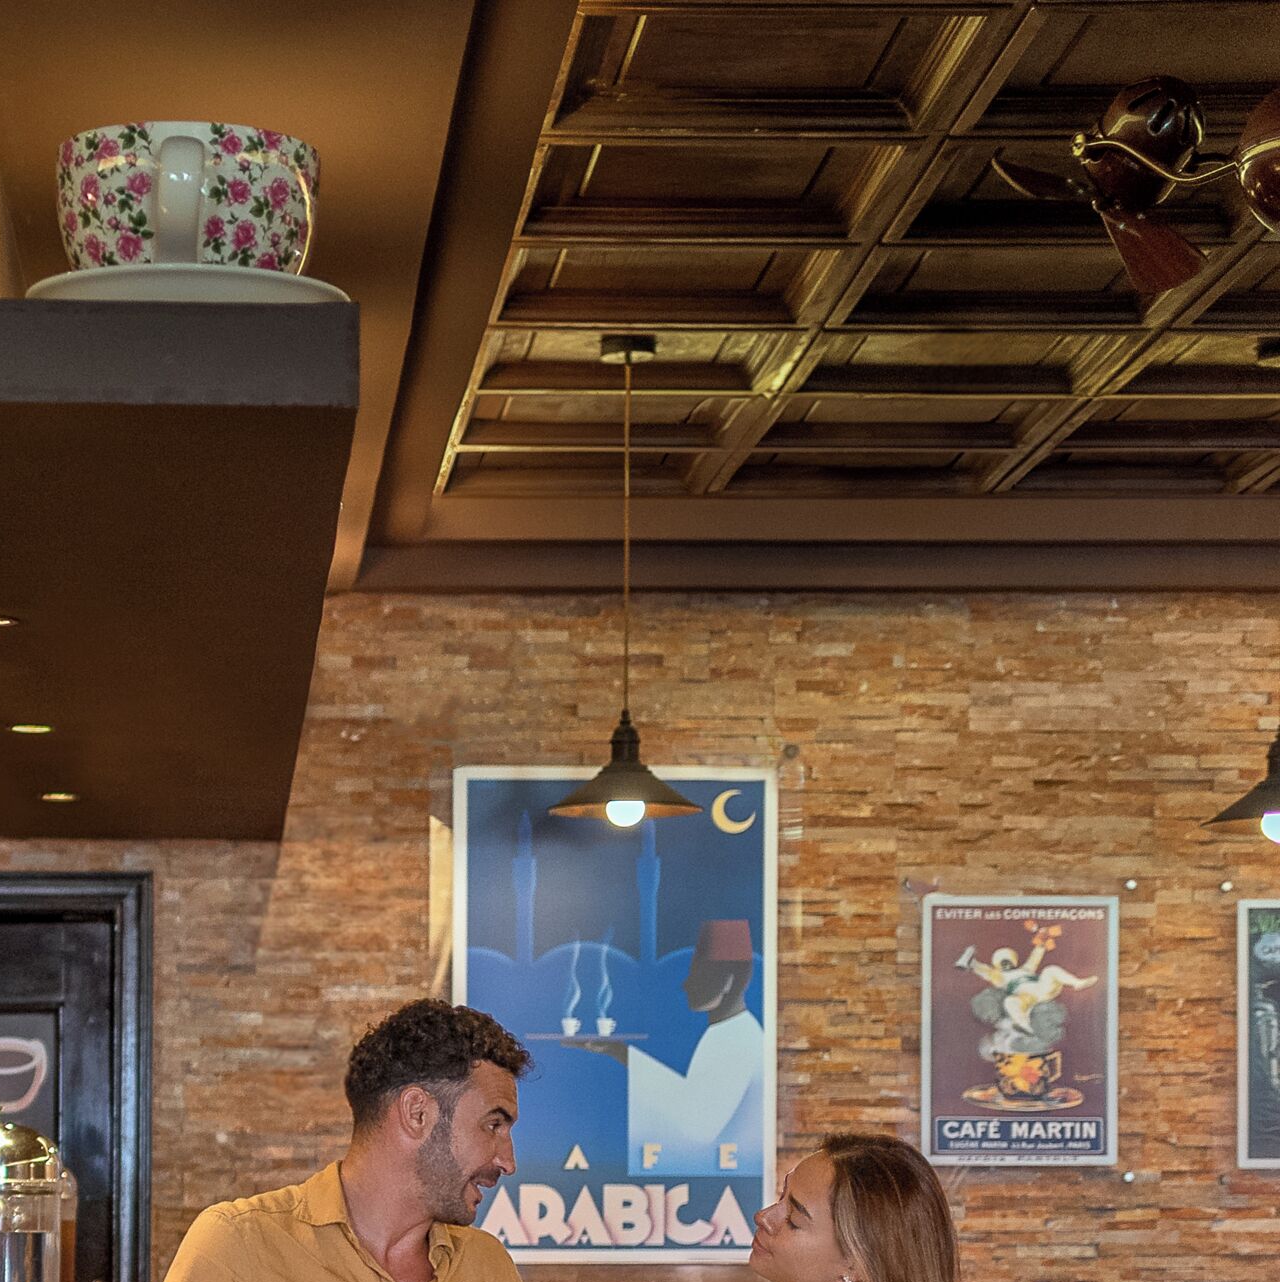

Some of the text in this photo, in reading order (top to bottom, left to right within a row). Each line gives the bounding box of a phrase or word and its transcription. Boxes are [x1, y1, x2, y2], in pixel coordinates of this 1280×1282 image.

[943, 1119, 1097, 1139] CAFÉ MARTIN
[564, 1143, 738, 1170] AFE
[480, 1184, 754, 1246] ARABICA
